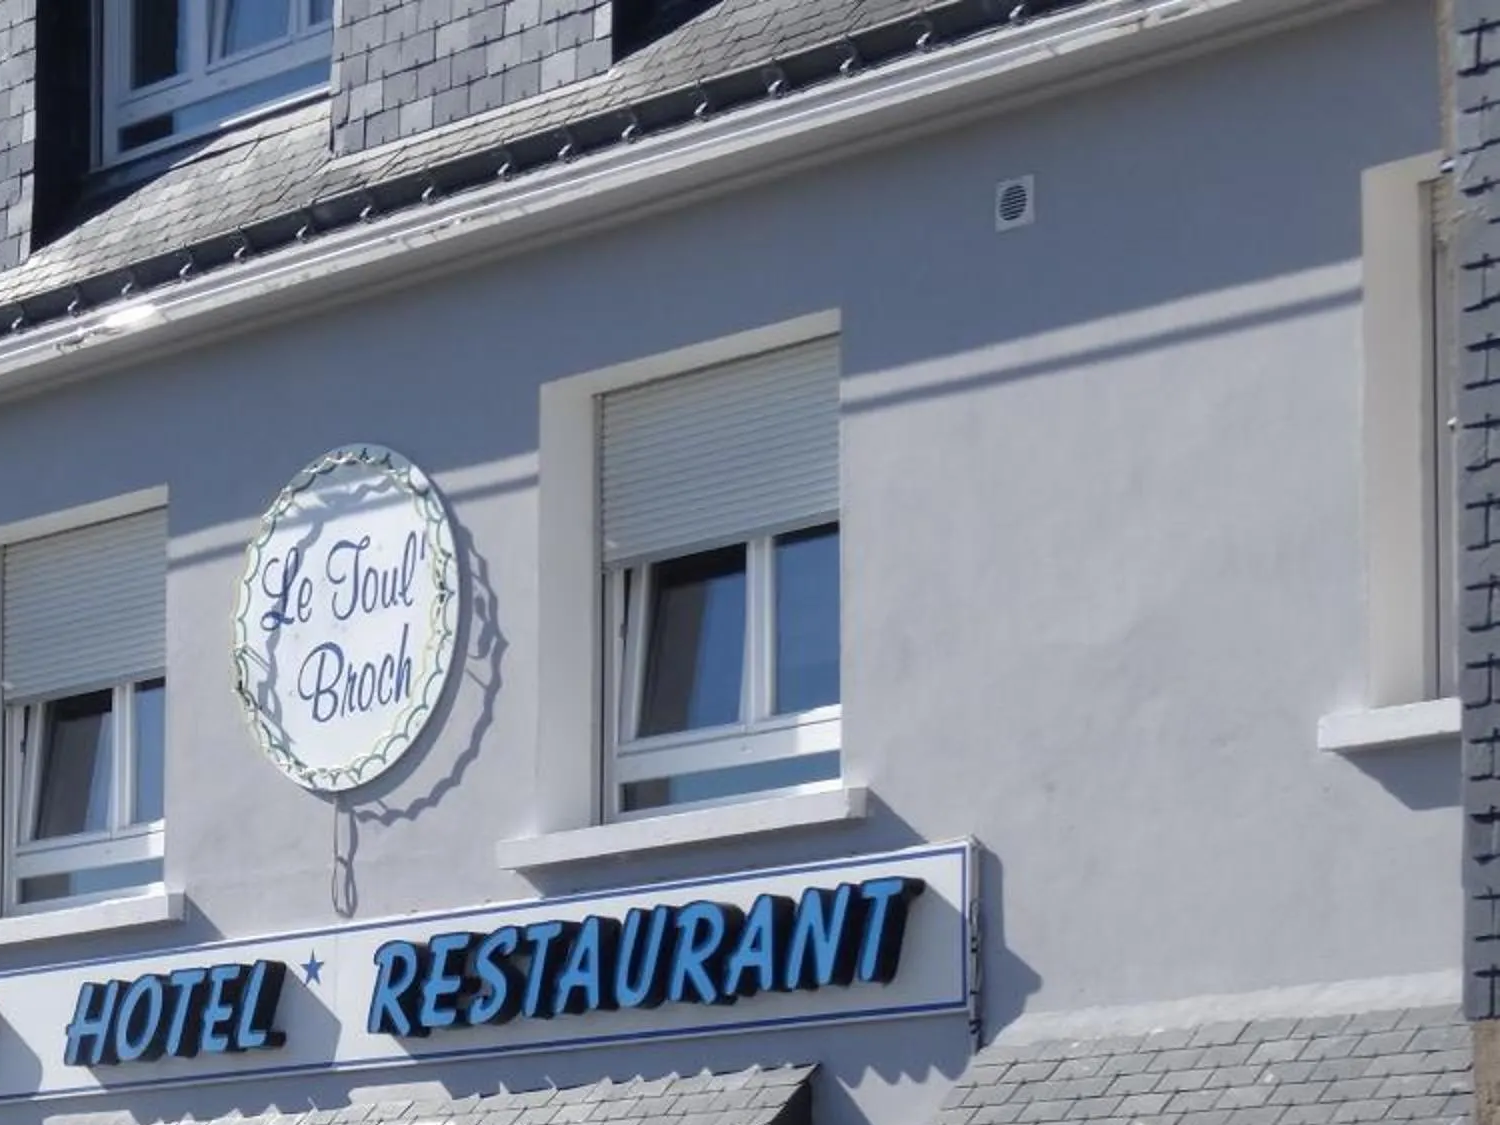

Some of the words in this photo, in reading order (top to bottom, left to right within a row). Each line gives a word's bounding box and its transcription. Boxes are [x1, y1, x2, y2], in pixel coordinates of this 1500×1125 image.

[260, 546, 313, 631] Le
[299, 622, 413, 724] Broch
[64, 959, 287, 1067] HOTEL
[367, 876, 925, 1038] RESTAURANT
